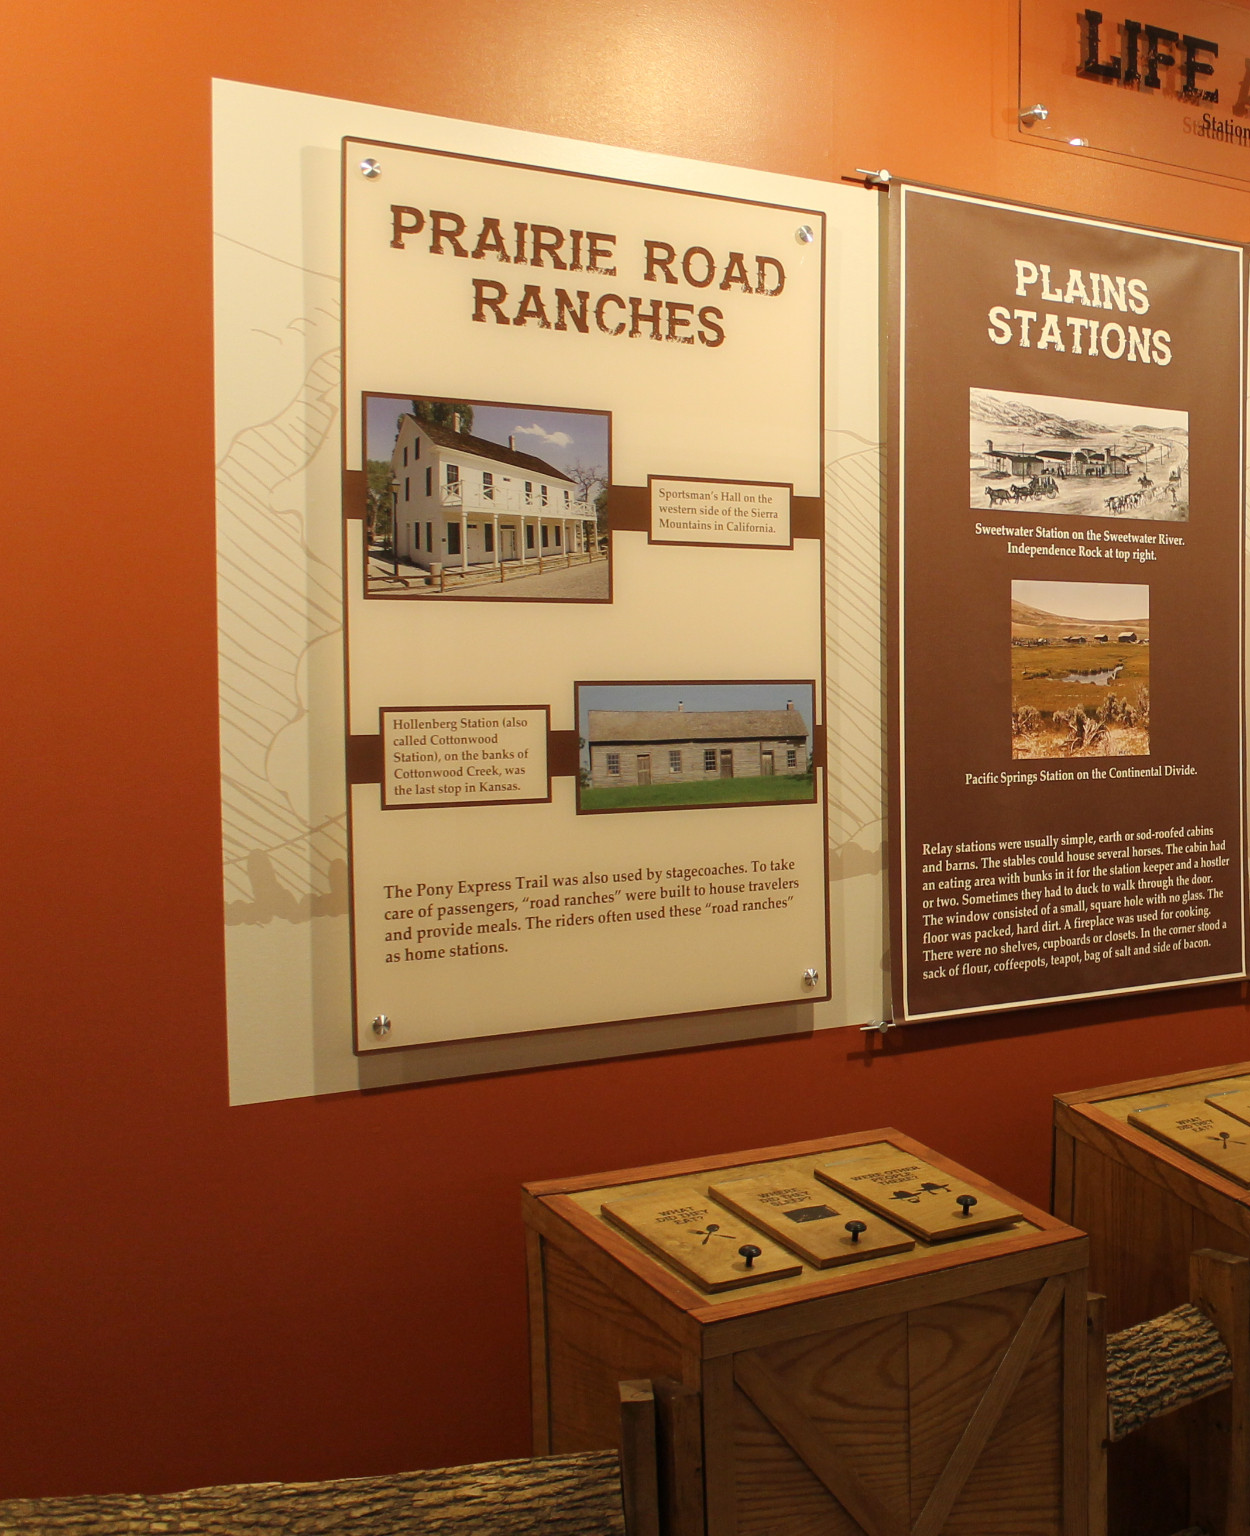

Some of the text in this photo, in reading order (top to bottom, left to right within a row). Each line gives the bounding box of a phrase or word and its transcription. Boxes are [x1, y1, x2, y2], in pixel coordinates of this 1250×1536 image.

[1075, 9, 1219, 104] LIFE
[389, 204, 787, 297] PRAIRIE ROAD
[1014, 258, 1150, 315] PLAINS
[472, 277, 726, 348] RANCHES
[987, 305, 1172, 366] STATIONS
[658, 488, 773, 503] Sportsman's Hall on the
[658, 505, 779, 518] western side of the Sierra
[658, 519, 776, 533] Mountains in California.
[974, 522, 1186, 545] Sweetwater Station on the Sweetwater River.
[1006, 541, 1157, 563] Independence Rock at top right.
[392, 717, 528, 732] Hollenberg Station (also
[392, 733, 499, 746] called Cottonwood
[444, 753, 458, 761] on
[461, 749, 478, 760] the
[481, 748, 514, 760] banks
[517, 748, 530, 759] of
[393, 765, 526, 778] Cottonwood Creek, was
[964, 765, 1198, 786] Pacific Springs Station on the Continental Divide.
[393, 781, 521, 797] the last stop in Kansas.
[922, 843, 952, 857] Relay
[955, 841, 995, 853] stations
[998, 841, 1021, 850] were
[1024, 836, 1058, 850] usually
[1060, 834, 1096, 848] simple,
[1098, 832, 1122, 843] earth
[1136, 828, 1184, 840] sod-roofed
[1186, 826, 1214, 837] cabins
[383, 859, 796, 900] The Pony Express Trail was also used by stagecoaches. To take
[922, 940, 1212, 980] sack of flour, coffeepots, teapot, bag of salt and side of bacon.
